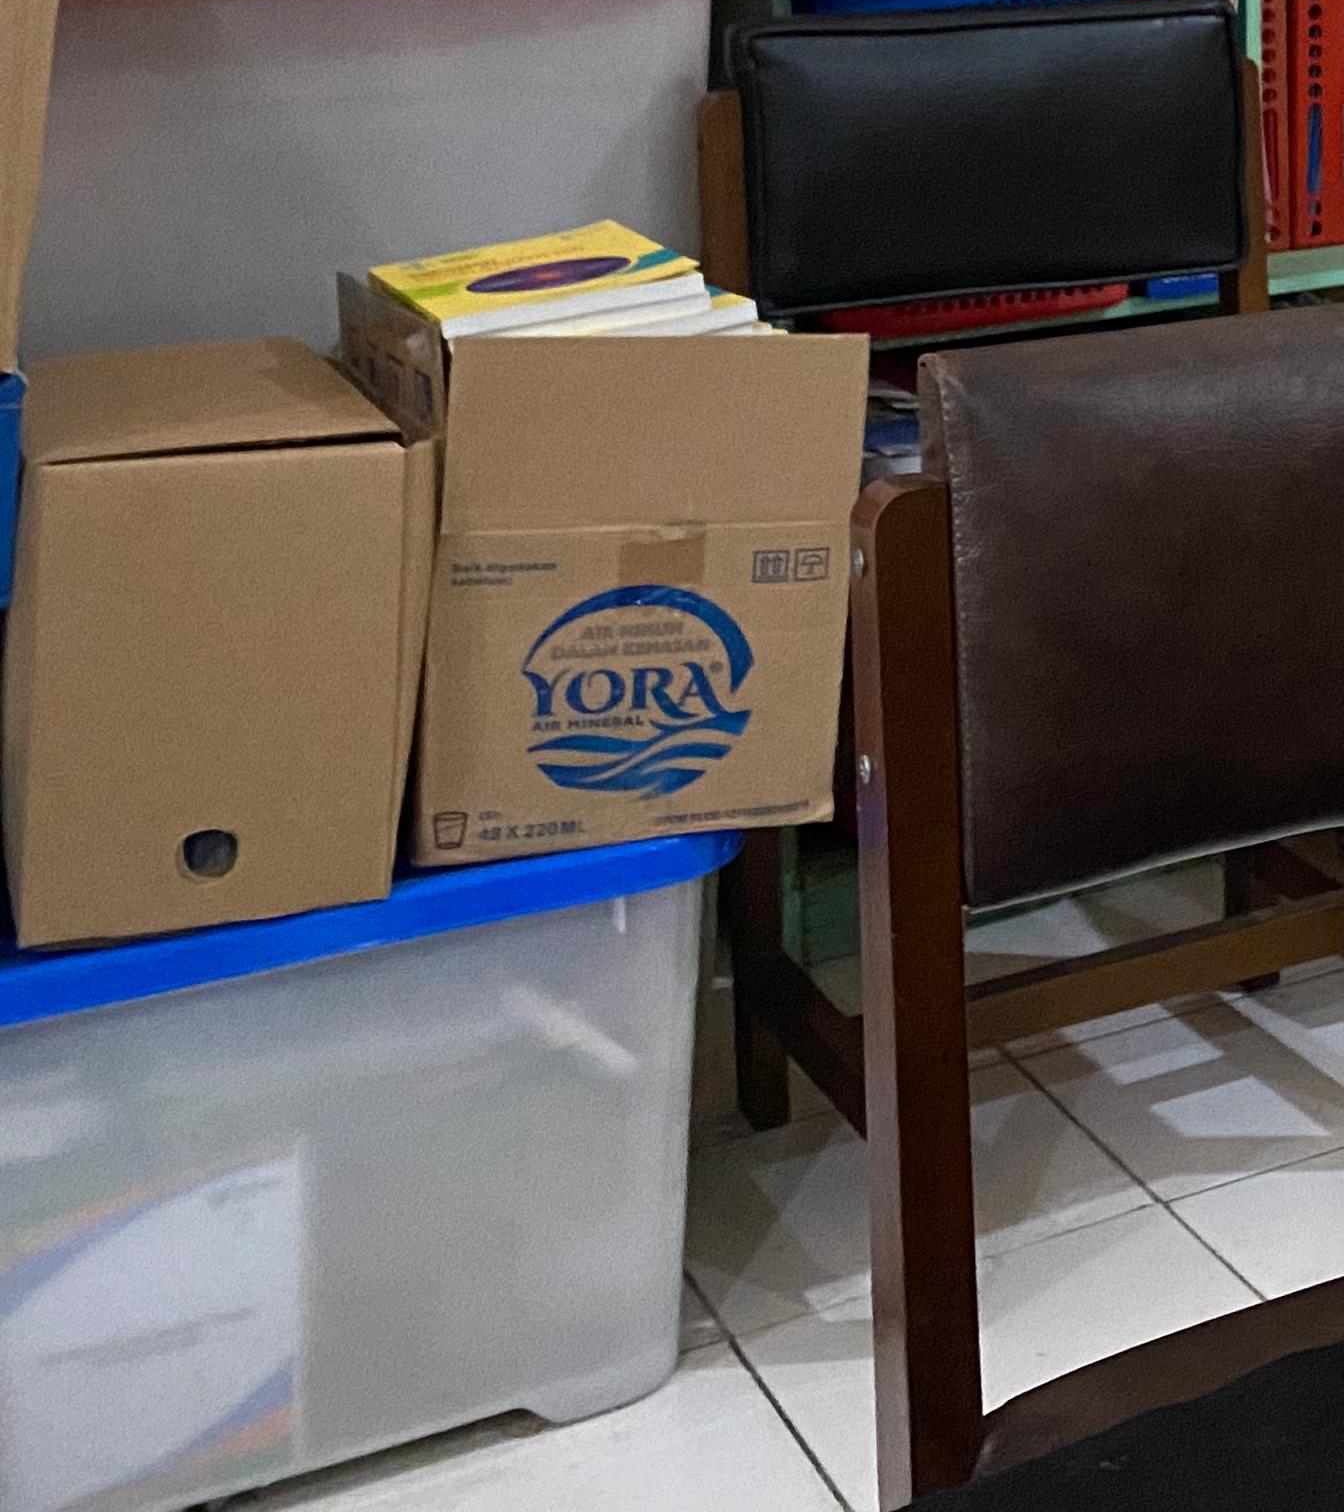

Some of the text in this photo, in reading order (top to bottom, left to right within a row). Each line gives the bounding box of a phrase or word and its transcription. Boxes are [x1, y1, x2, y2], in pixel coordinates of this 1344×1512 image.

[522, 662, 720, 719] YORA
[533, 716, 644, 733] AIR MINERAL
